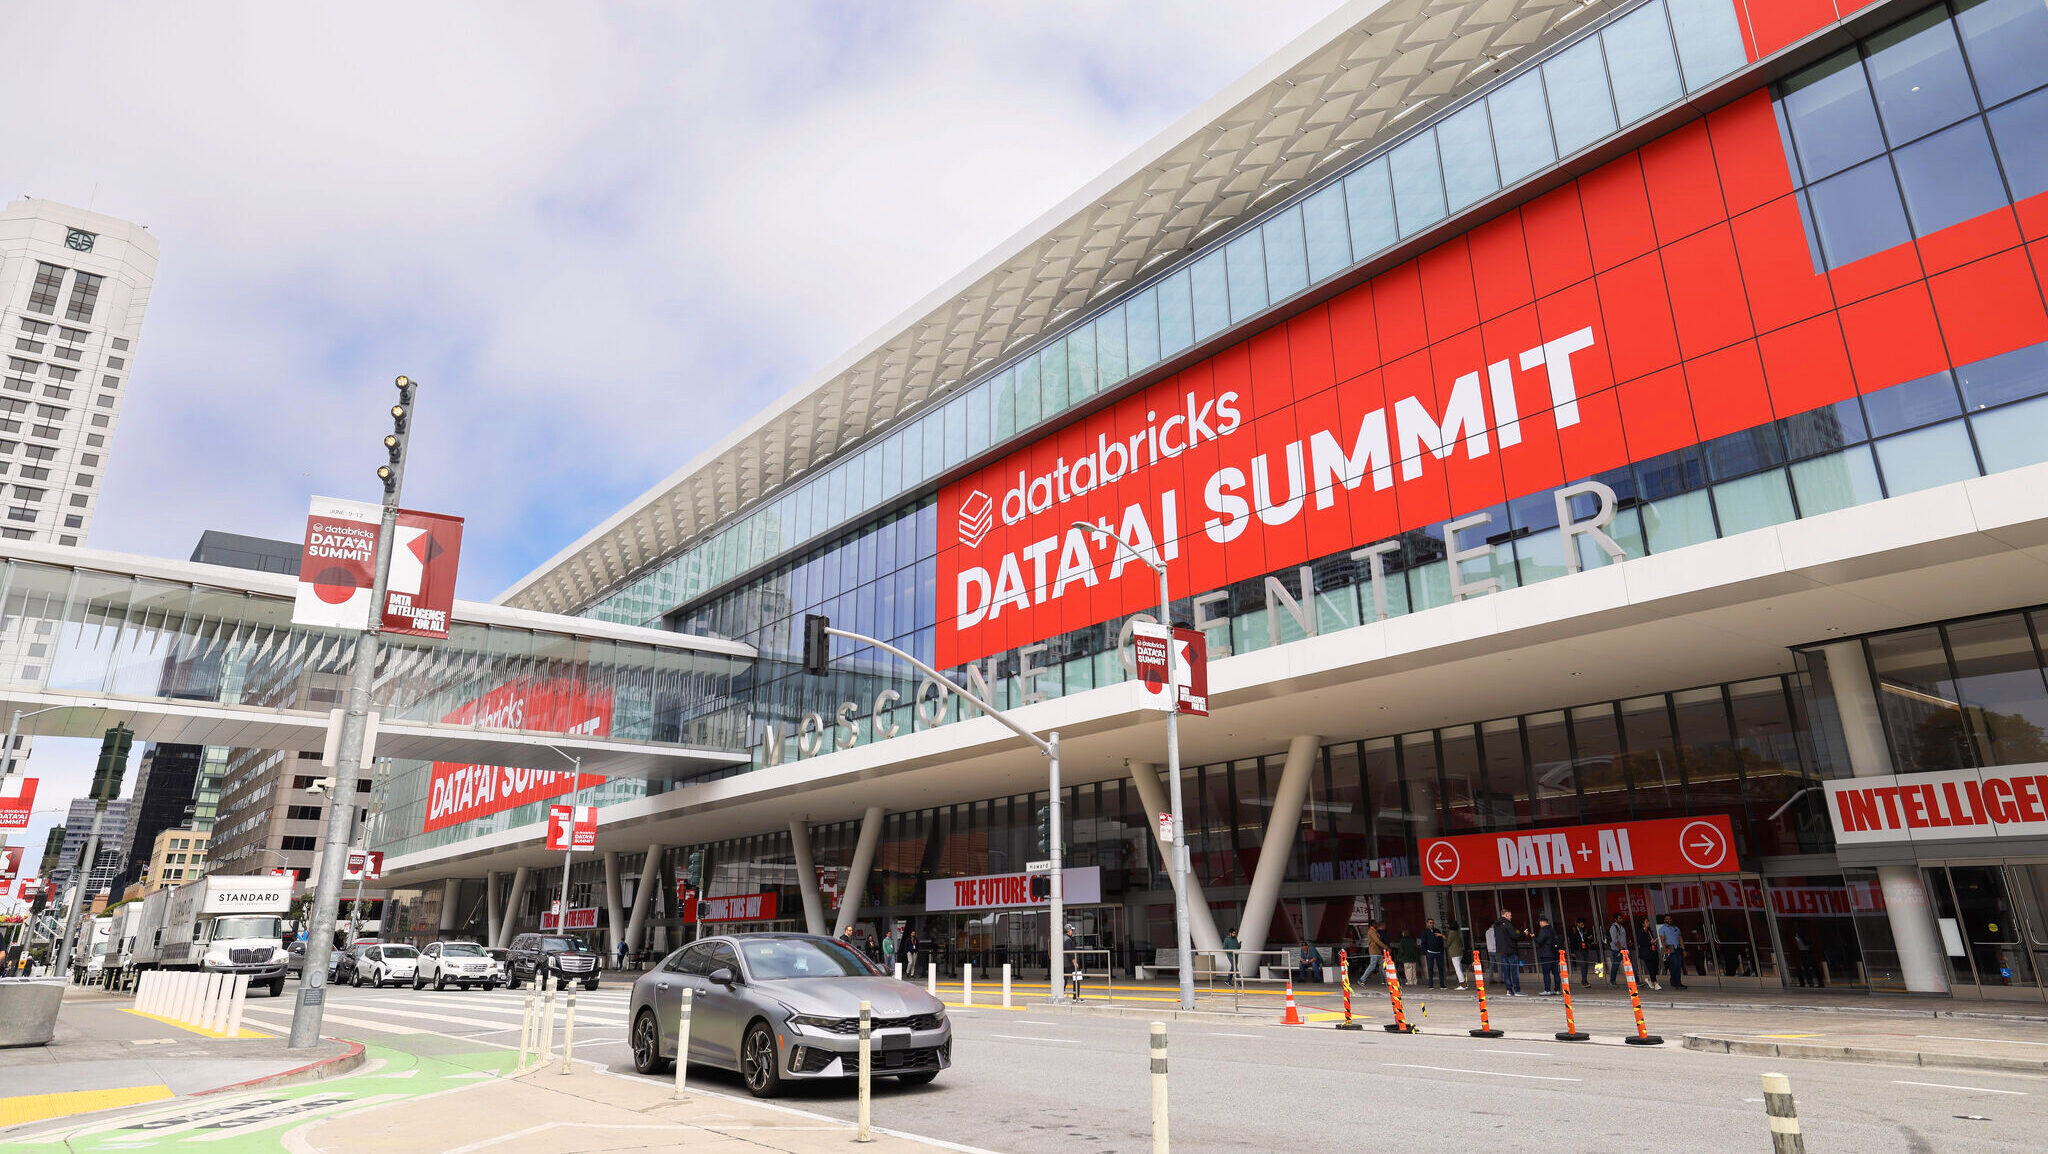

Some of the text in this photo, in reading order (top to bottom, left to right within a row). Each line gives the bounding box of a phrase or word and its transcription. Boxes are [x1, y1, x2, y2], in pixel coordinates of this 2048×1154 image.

[1001, 391, 1241, 526] databricks
[956, 326, 1595, 631] DATA+AI SUMMIT
[324, 523, 374, 539] databricks
[310, 533, 373, 551] DATA+AI
[309, 545, 372, 562] SUMMIT
[389, 593, 412, 607] DATA
[387, 603, 446, 621] INTELLIGENCE
[412, 617, 446, 632] FOR ALL
[763, 481, 1626, 768] MOSCONE CENTER
[1138, 655, 1166, 666] SUMMIT
[1497, 833, 1574, 877] DATA
[1598, 828, 1634, 871] AI
[219, 893, 280, 902] STANDARD
[954, 879, 976, 906] THE
[978, 876, 1027, 905] FUTURE
[729, 898, 745, 918] THIS
